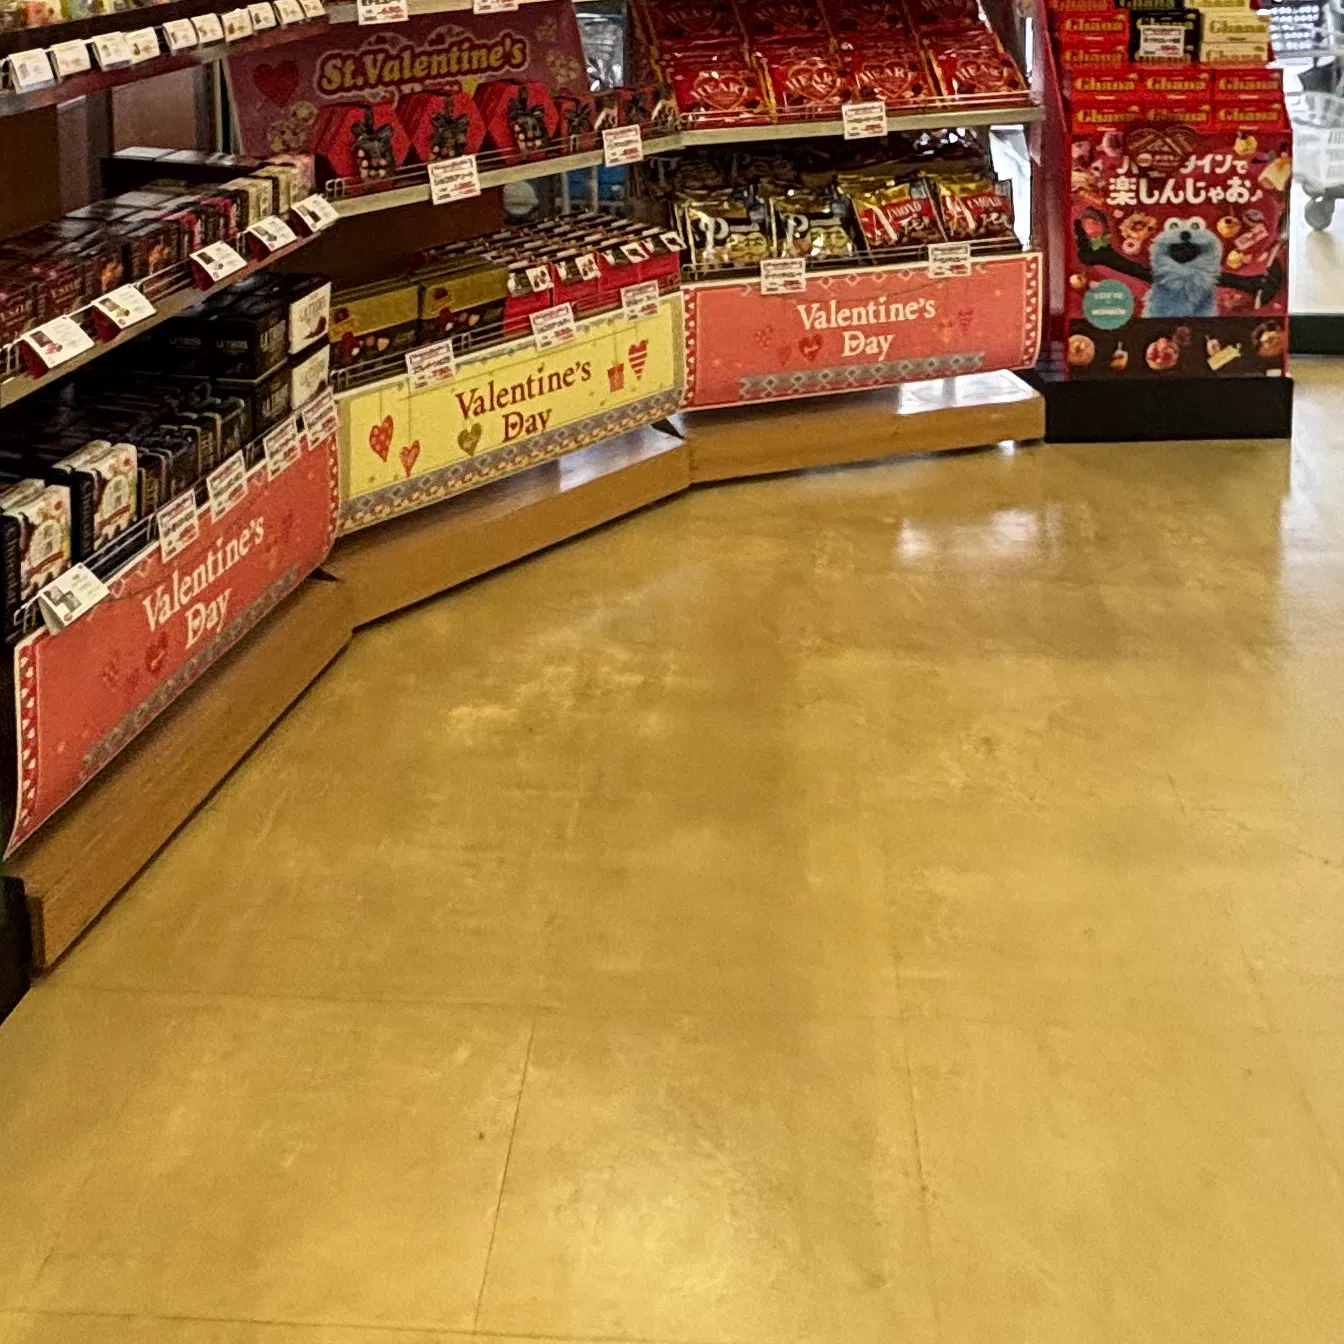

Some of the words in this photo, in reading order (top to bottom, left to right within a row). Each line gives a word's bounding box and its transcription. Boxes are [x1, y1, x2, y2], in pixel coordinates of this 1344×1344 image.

[797, 296, 937, 332] Valentine's
[842, 331, 896, 361] Day
[456, 359, 593, 421] Valentine's
[503, 409, 553, 443] Day
[142, 514, 266, 632] Valentine's
[185, 588, 234, 650] Day
